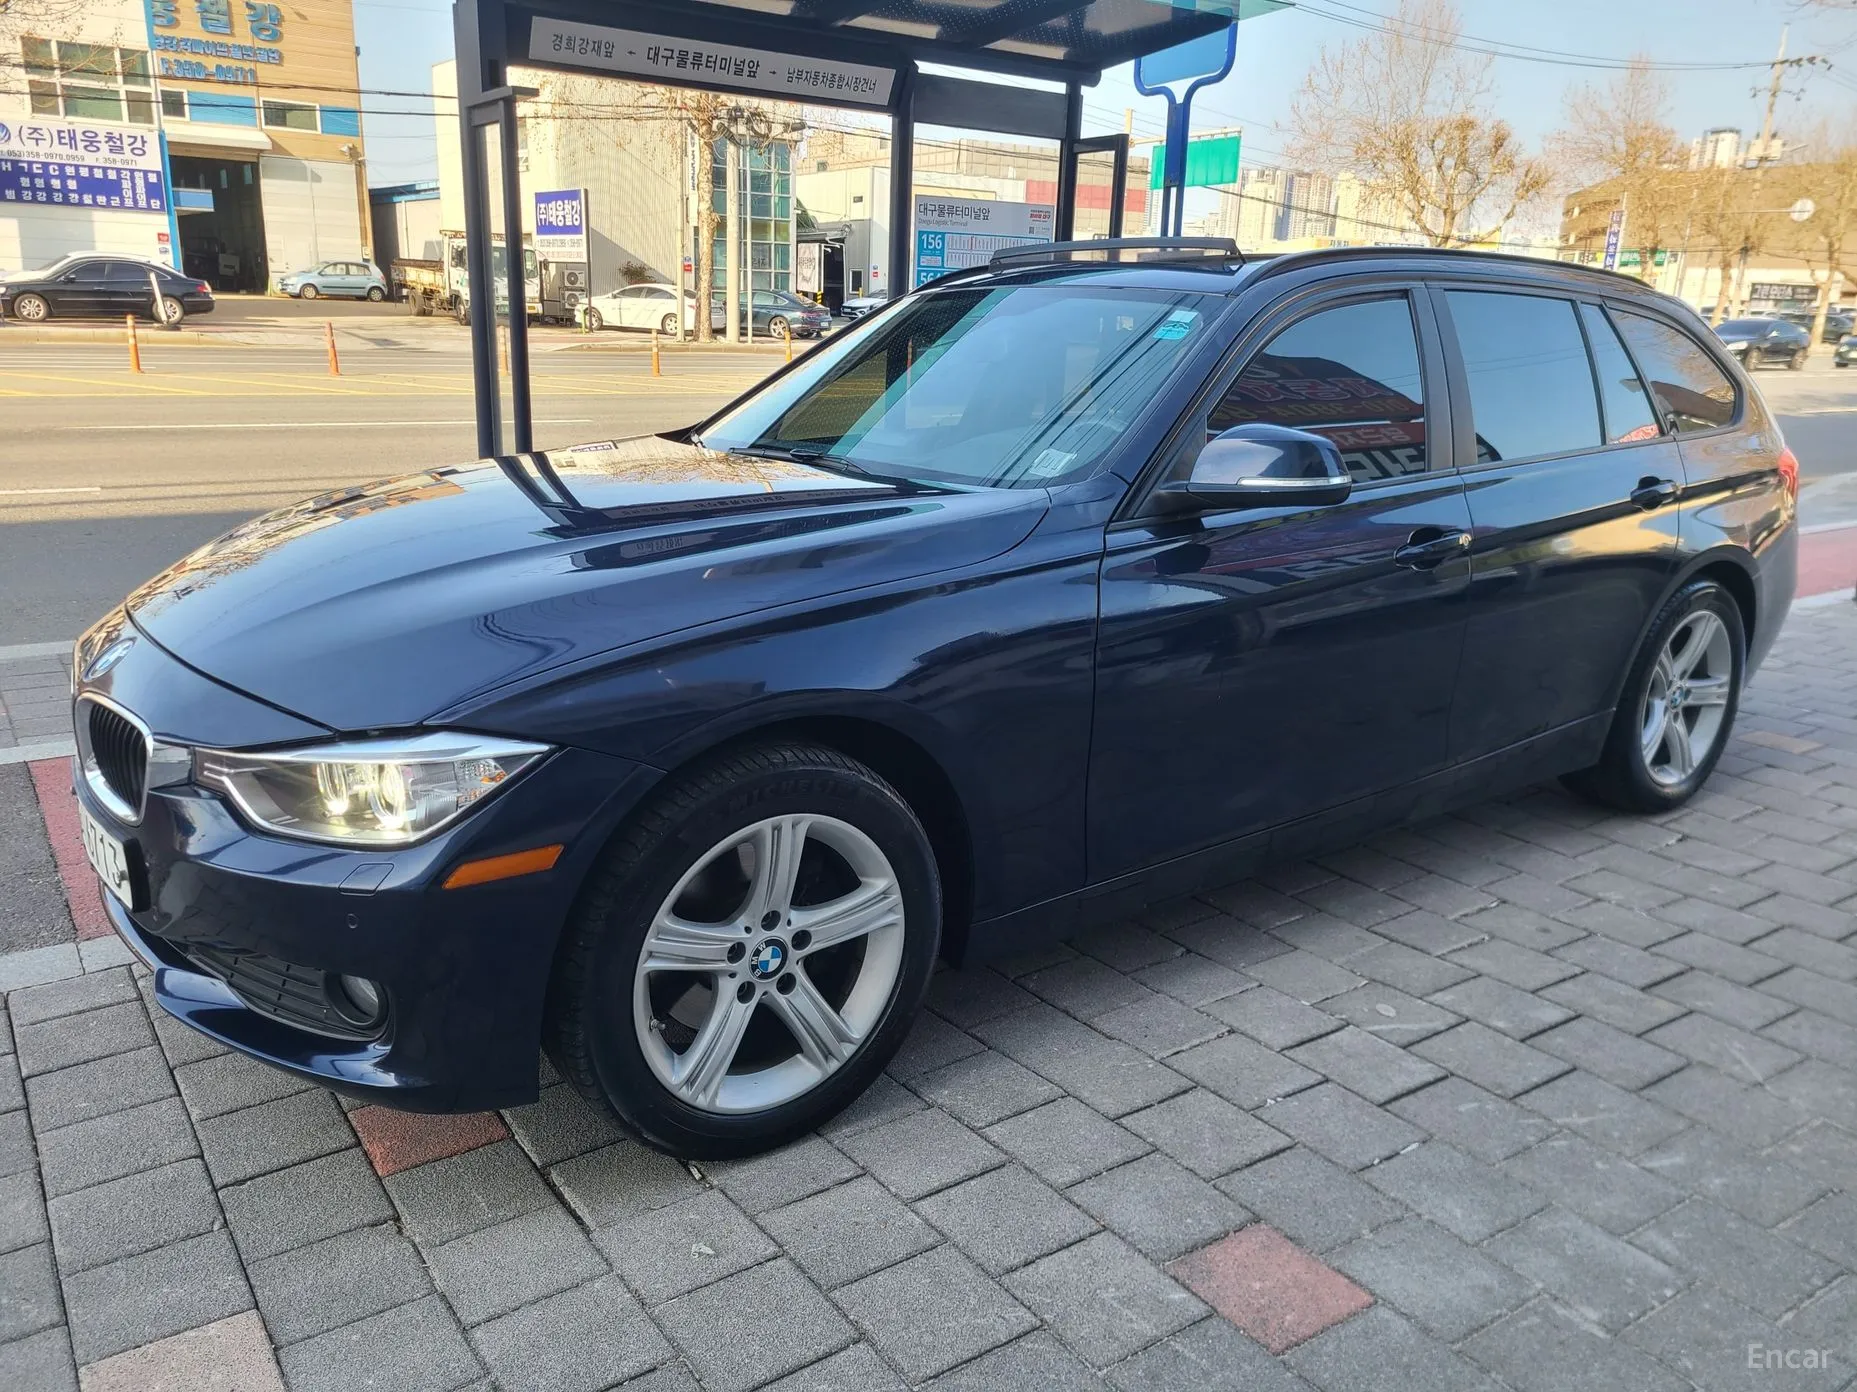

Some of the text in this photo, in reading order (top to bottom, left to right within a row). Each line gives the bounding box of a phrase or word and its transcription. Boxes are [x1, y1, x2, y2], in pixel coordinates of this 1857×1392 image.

[552, 33, 877, 94] 경희강재앞 대구물류터미널앞 남부자동차종합시장건너
[18, 125, 148, 157] (주)태웅철강
[918, 203, 990, 220] 대구물류터미널앞
[921, 234, 942, 249] 156
